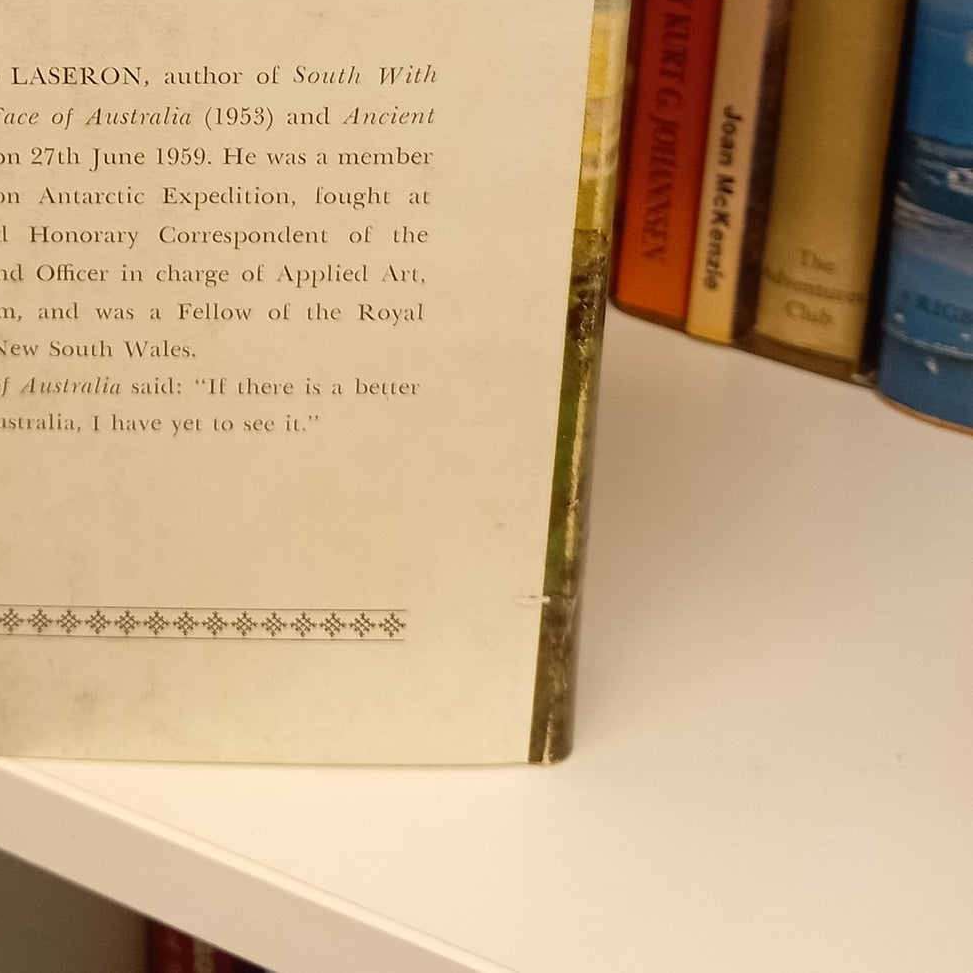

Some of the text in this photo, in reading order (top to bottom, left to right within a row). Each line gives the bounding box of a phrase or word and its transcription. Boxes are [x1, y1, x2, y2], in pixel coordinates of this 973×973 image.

[10, 66, 149, 87] LASERON,
[164, 65, 244, 84] author
[256, 64, 281, 84] of
[292, 64, 361, 84] South
[378, 63, 437, 85] With
[51, 107, 75, 130] of
[84, 105, 192, 125] Australia
[204, 106, 274, 131] (1953)
[286, 105, 331, 125] and
[342, 105, 436, 125] Ancient
[30, 146, 81, 166] 27th
[88, 147, 146, 172] June
[156, 146, 212, 165] 1959.
[222, 146, 257, 165] He
[265, 152, 307, 165] was
[316, 151, 329, 164] a
[337, 146, 434, 165] member
[38, 185, 145, 205] Antarctic
[161, 185, 296, 211] Expedition,
[314, 186, 391, 210] fought
[408, 189, 431, 205] at
[704, 105, 744, 292] Joan McKenzie
[28, 225, 139, 249] Honorary
[158, 225, 329, 250] Correspondent
[348, 225, 373, 243] of
[393, 225, 430, 243] the
[36, 263, 110, 282] Officer
[120, 263, 144, 281] in
[155, 263, 230, 287] charge
[241, 263, 265, 282] of
[276, 263, 369, 288] Applied
[380, 264, 426, 284] Art,
[38, 301, 80, 319] and
[94, 307, 135, 320] was
[149, 307, 162, 320] a
[177, 302, 253, 320] Fellow
[267, 302, 291, 320] of
[307, 302, 342, 320] the
[357, 302, 424, 326] Royal
[784, 299, 835, 325] Club
[48, 339, 114, 357] South
[123, 339, 196, 358] Wales.
[19, 375, 122, 395] Australia
[130, 376, 182, 395] said:
[194, 377, 228, 395] “If
[238, 377, 294, 395] there
[305, 377, 321, 395] is
[331, 383, 343, 395] a
[354, 377, 421, 395] better
[93, 414, 101, 431] I
[111, 413, 162, 431] have
[171, 417, 202, 435] yet
[213, 417, 234, 431] to
[243, 418, 276, 432] see
[285, 414, 319, 432] it.”
